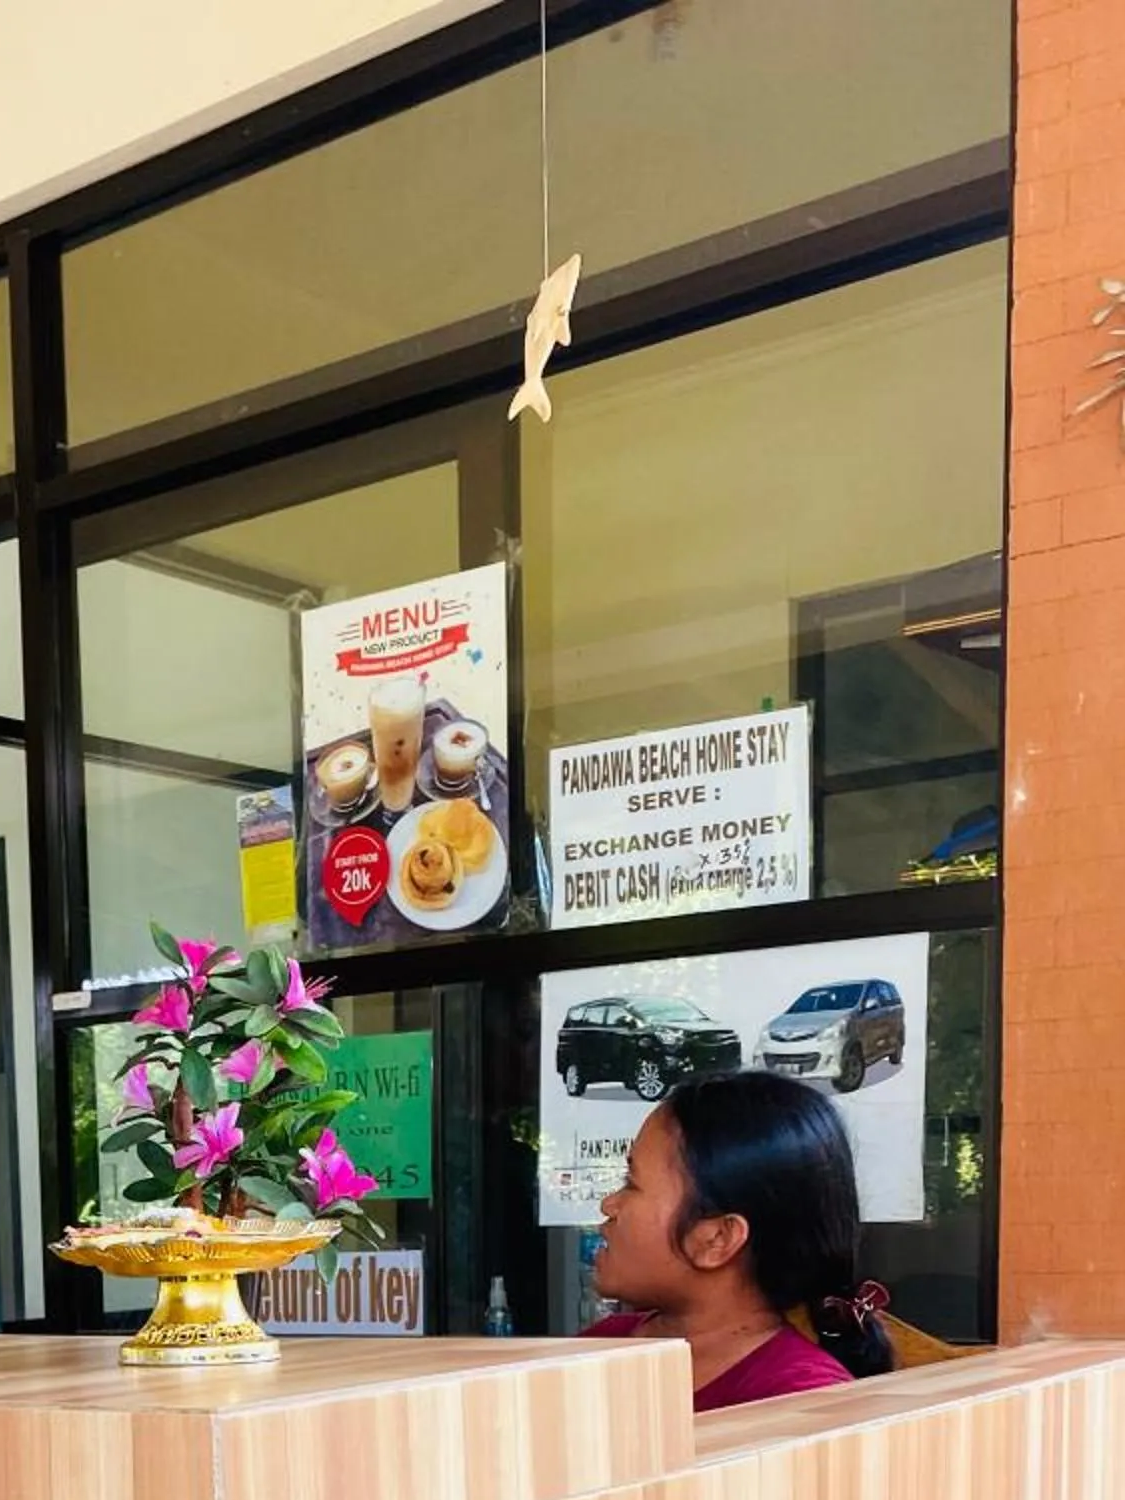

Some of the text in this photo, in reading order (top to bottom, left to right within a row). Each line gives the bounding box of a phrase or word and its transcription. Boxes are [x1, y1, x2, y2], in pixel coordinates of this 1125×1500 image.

[362, 599, 439, 640] MENU
[364, 629, 439, 654] NEW PRODUCT
[561, 721, 790, 796] PANDAWA BEACH HOME STAY
[628, 785, 706, 813] SERVE
[564, 813, 792, 861] EXCHANGE MONEY
[341, 867, 372, 893] 20k
[564, 871, 611, 911] DEBIT
[616, 862, 660, 904] CASH
[376, 1064, 420, 1099] Wi-fi
[335, 1256, 362, 1323] of
[369, 1255, 420, 1331] key
